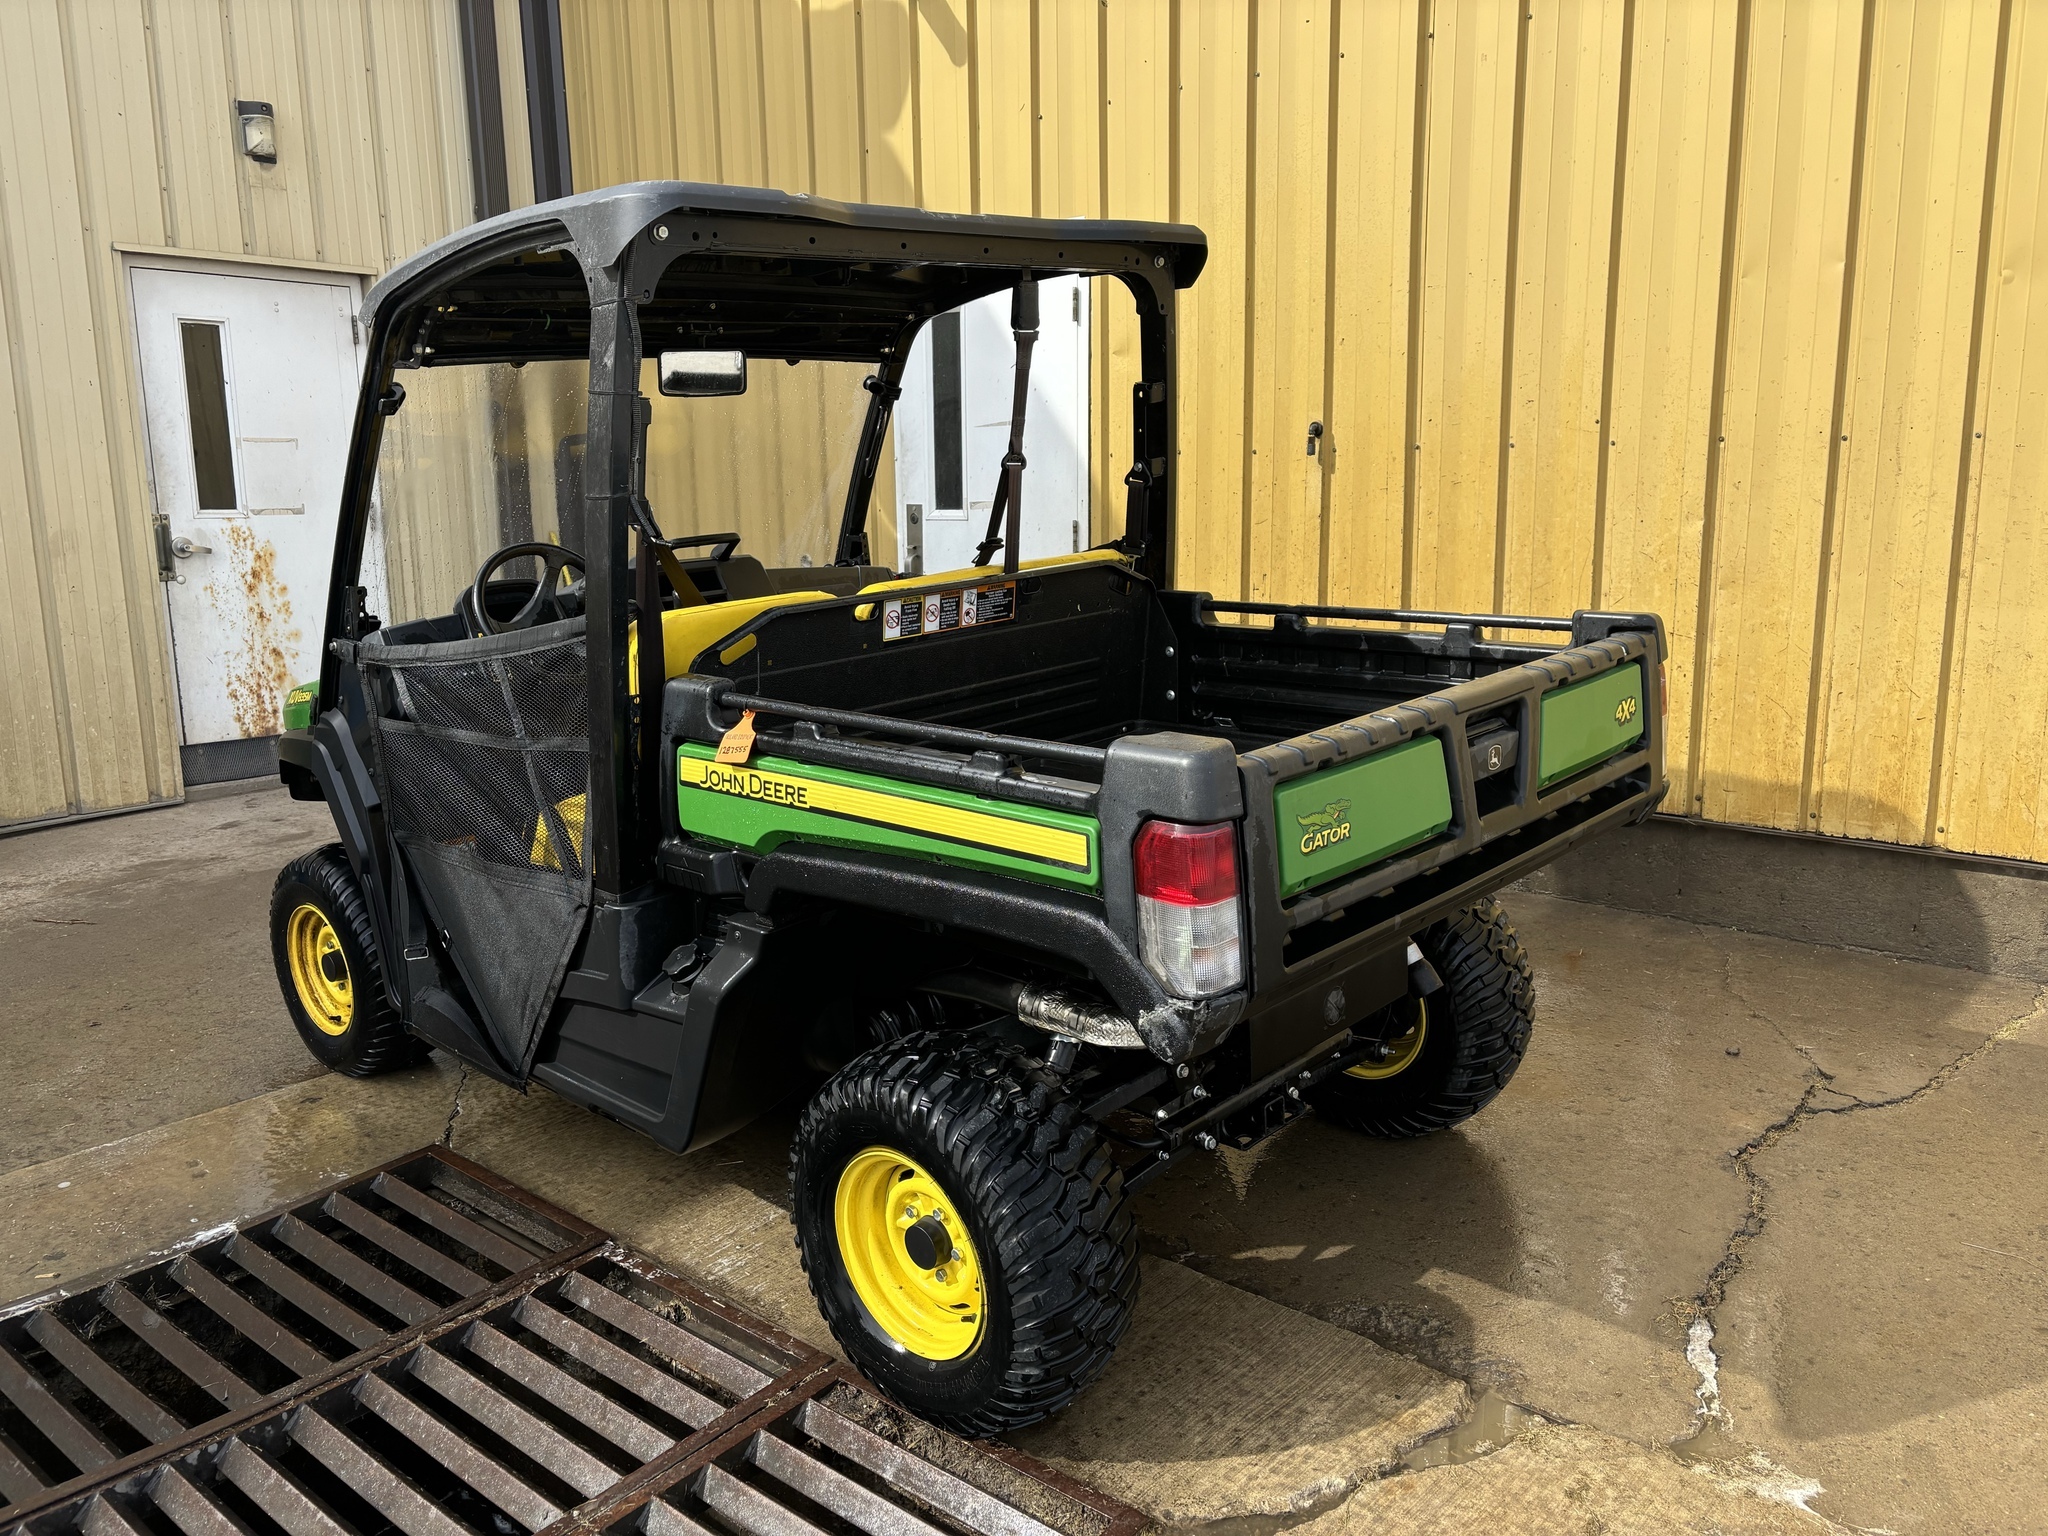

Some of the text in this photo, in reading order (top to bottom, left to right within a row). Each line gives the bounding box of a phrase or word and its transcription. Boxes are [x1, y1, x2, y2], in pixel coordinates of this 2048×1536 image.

[1616, 697, 1636, 723] 4X4
[700, 765, 808, 805] JOHN DEERE
[1300, 822, 1351, 854] GATOR
